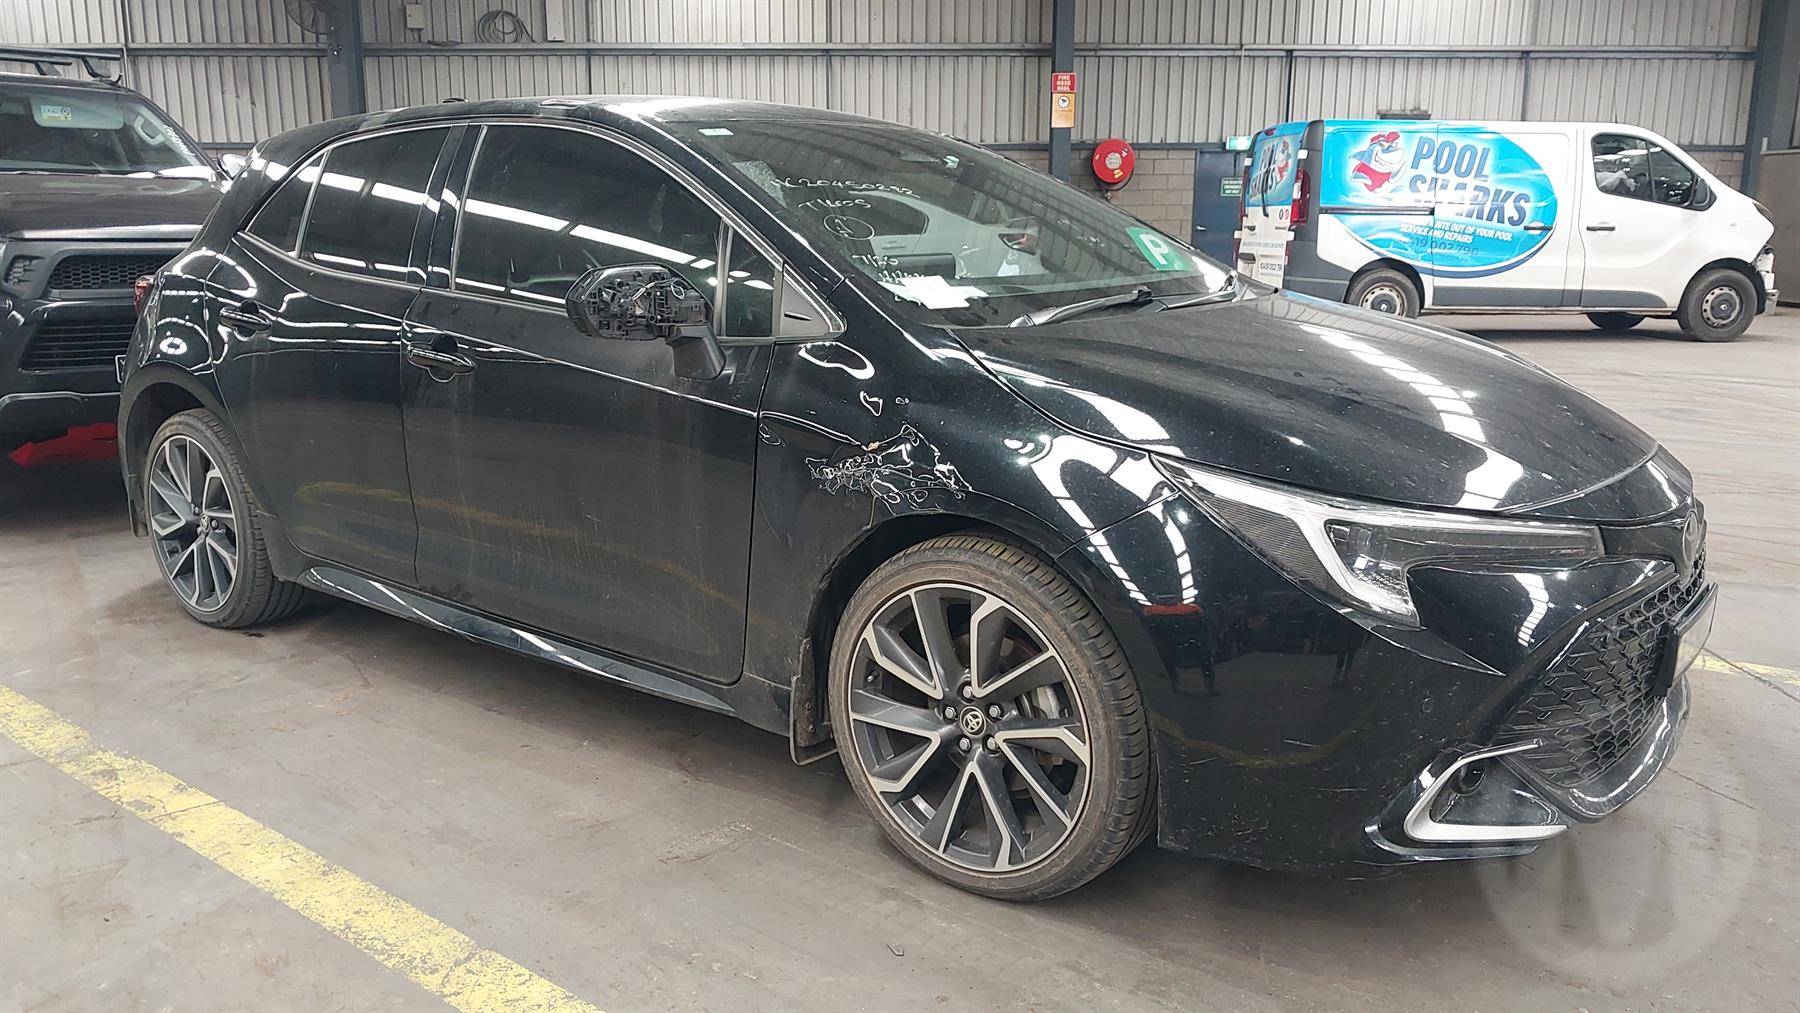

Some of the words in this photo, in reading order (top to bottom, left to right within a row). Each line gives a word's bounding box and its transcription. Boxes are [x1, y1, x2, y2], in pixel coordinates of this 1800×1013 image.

[1410, 136, 1491, 182] POOL
[1400, 224, 1428, 236] SERVICE
[1428, 229, 1444, 239] AND
[1444, 231, 1474, 243] REPAIRS
[1450, 223, 1465, 233] OUT
[1465, 225, 1475, 234] OF
[1476, 228, 1495, 238] YOUR
[1494, 231, 1513, 241] POOL
[1139, 233, 1169, 265] P
